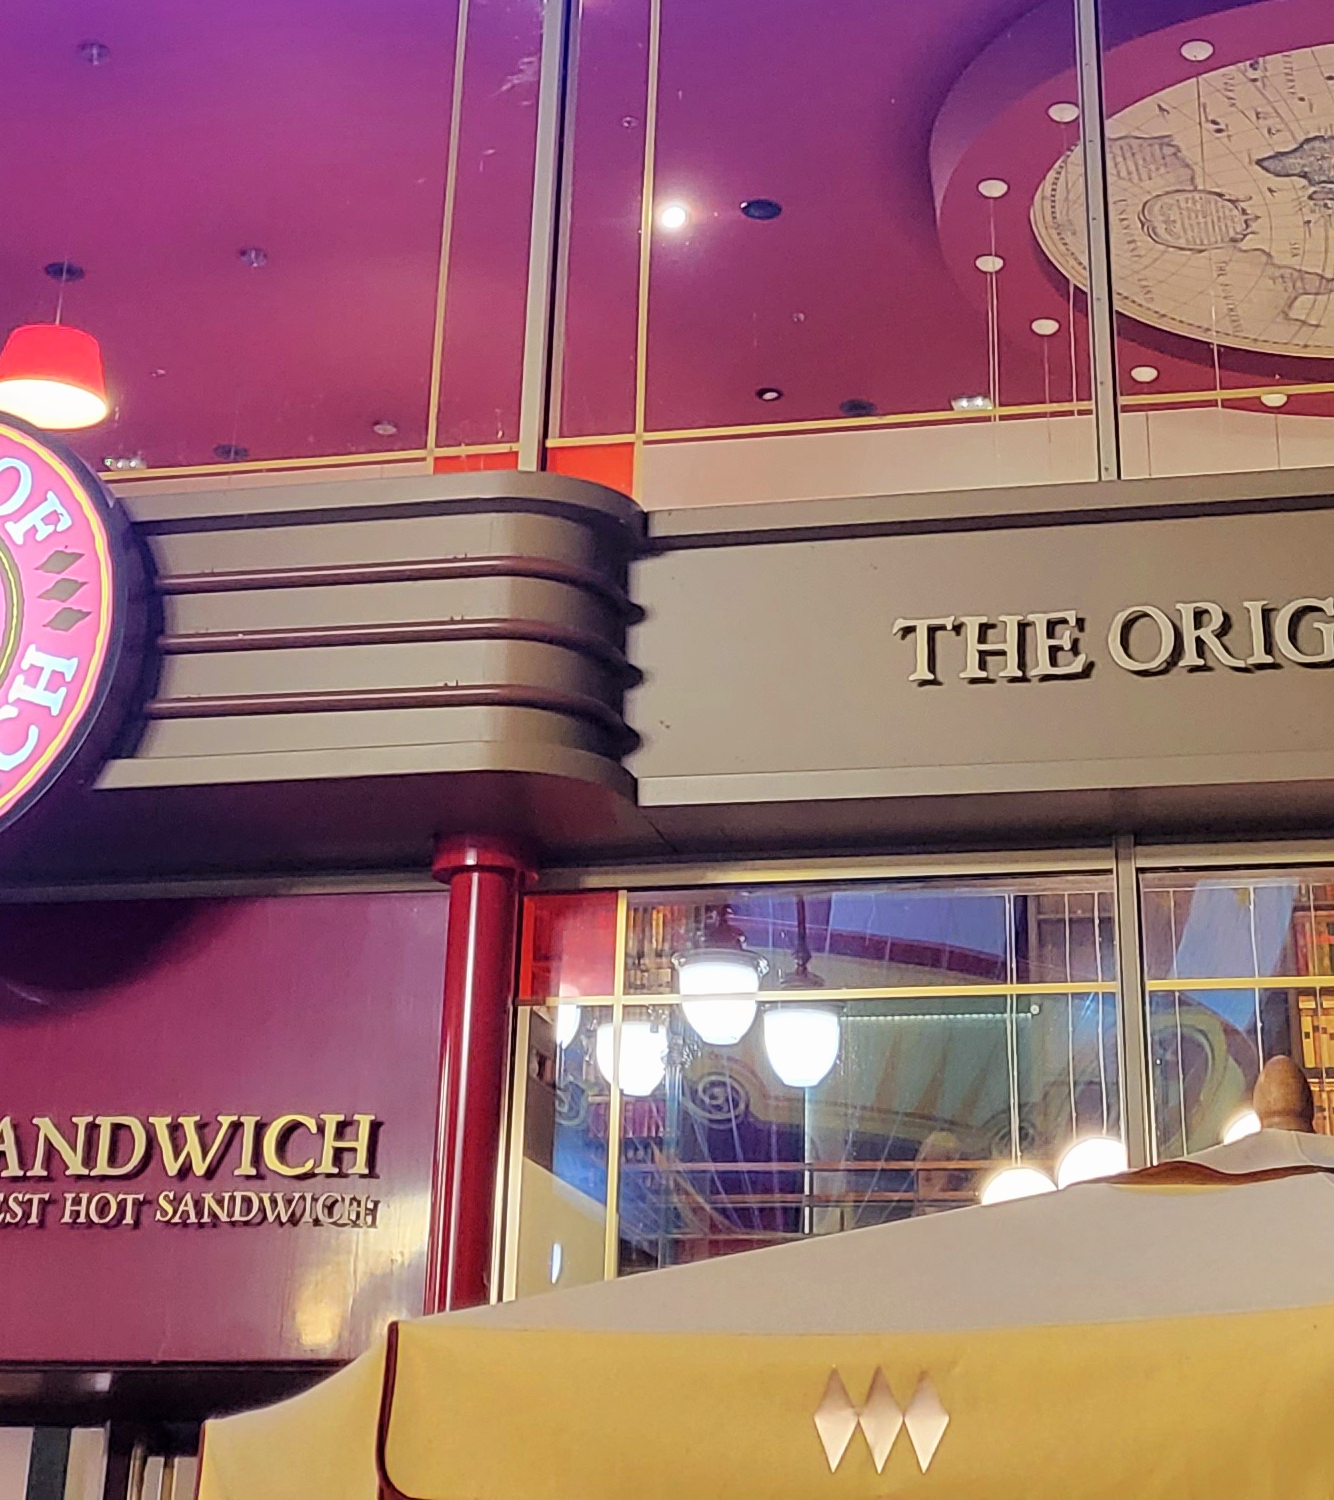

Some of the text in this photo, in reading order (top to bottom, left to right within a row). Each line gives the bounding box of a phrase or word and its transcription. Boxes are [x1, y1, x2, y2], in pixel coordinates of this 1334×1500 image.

[892, 610, 1087, 682] THE
[61, 1192, 144, 1224] HOT
[155, 1190, 370, 1225] SANDWICH
